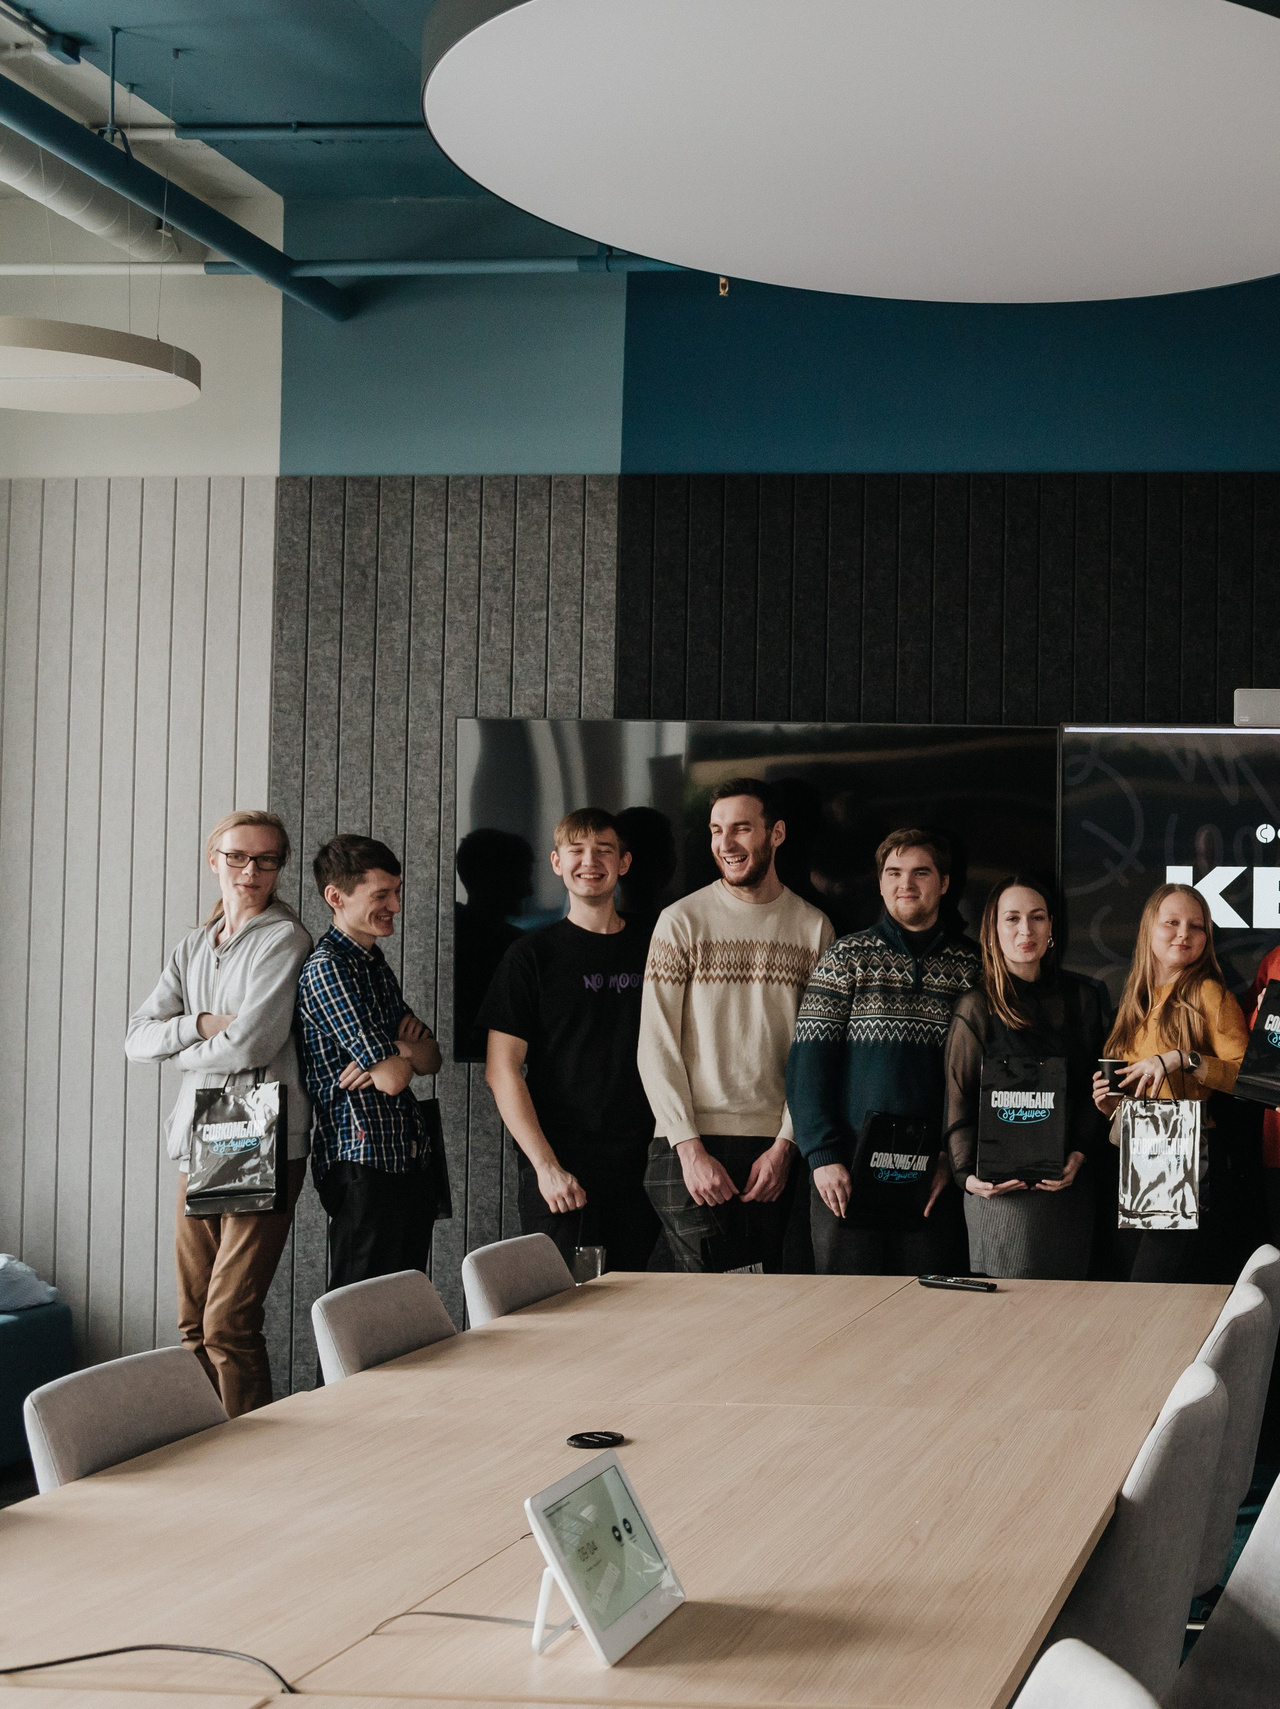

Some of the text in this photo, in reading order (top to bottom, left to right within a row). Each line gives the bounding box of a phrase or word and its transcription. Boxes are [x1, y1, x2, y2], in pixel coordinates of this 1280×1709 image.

[583, 973, 643, 993] NO MOO
[991, 1090, 1055, 1109] СОВКОМБАНК
